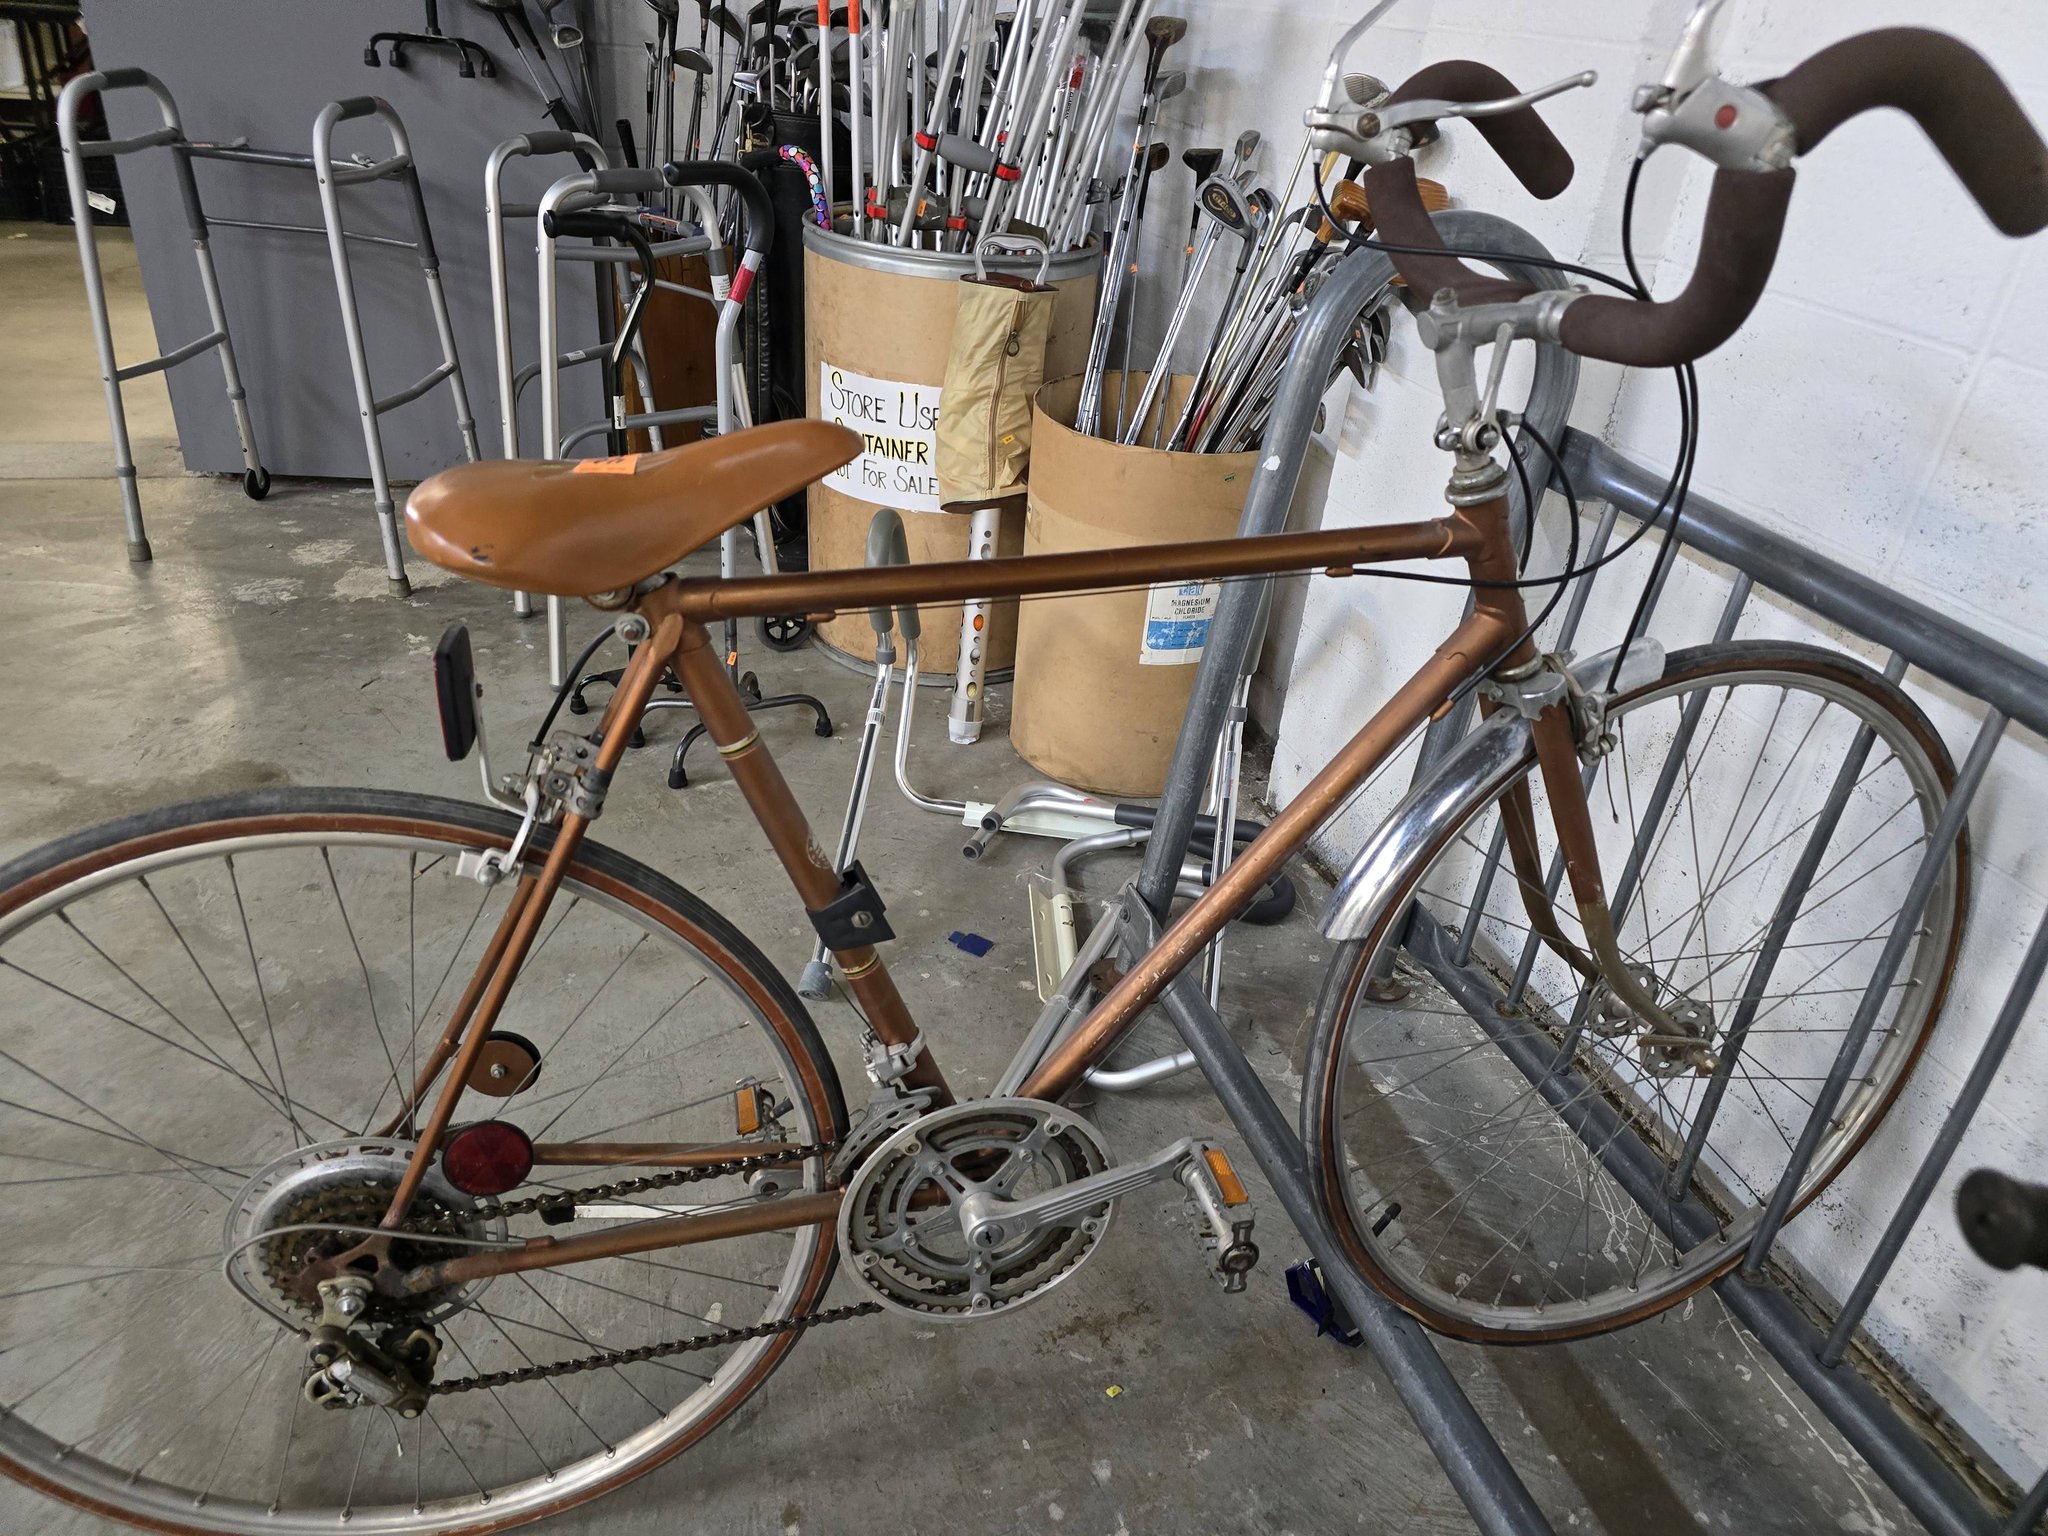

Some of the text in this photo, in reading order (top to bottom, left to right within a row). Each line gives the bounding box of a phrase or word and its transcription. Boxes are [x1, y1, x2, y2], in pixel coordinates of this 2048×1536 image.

[830, 371, 887, 424] STORE
[834, 416, 929, 466] TAINER
[862, 459, 887, 490] FOR
[893, 465, 940, 496] SALE
[1170, 597, 1211, 607] MAGNESIUM
[1174, 606, 1206, 616] CHLORIDE
